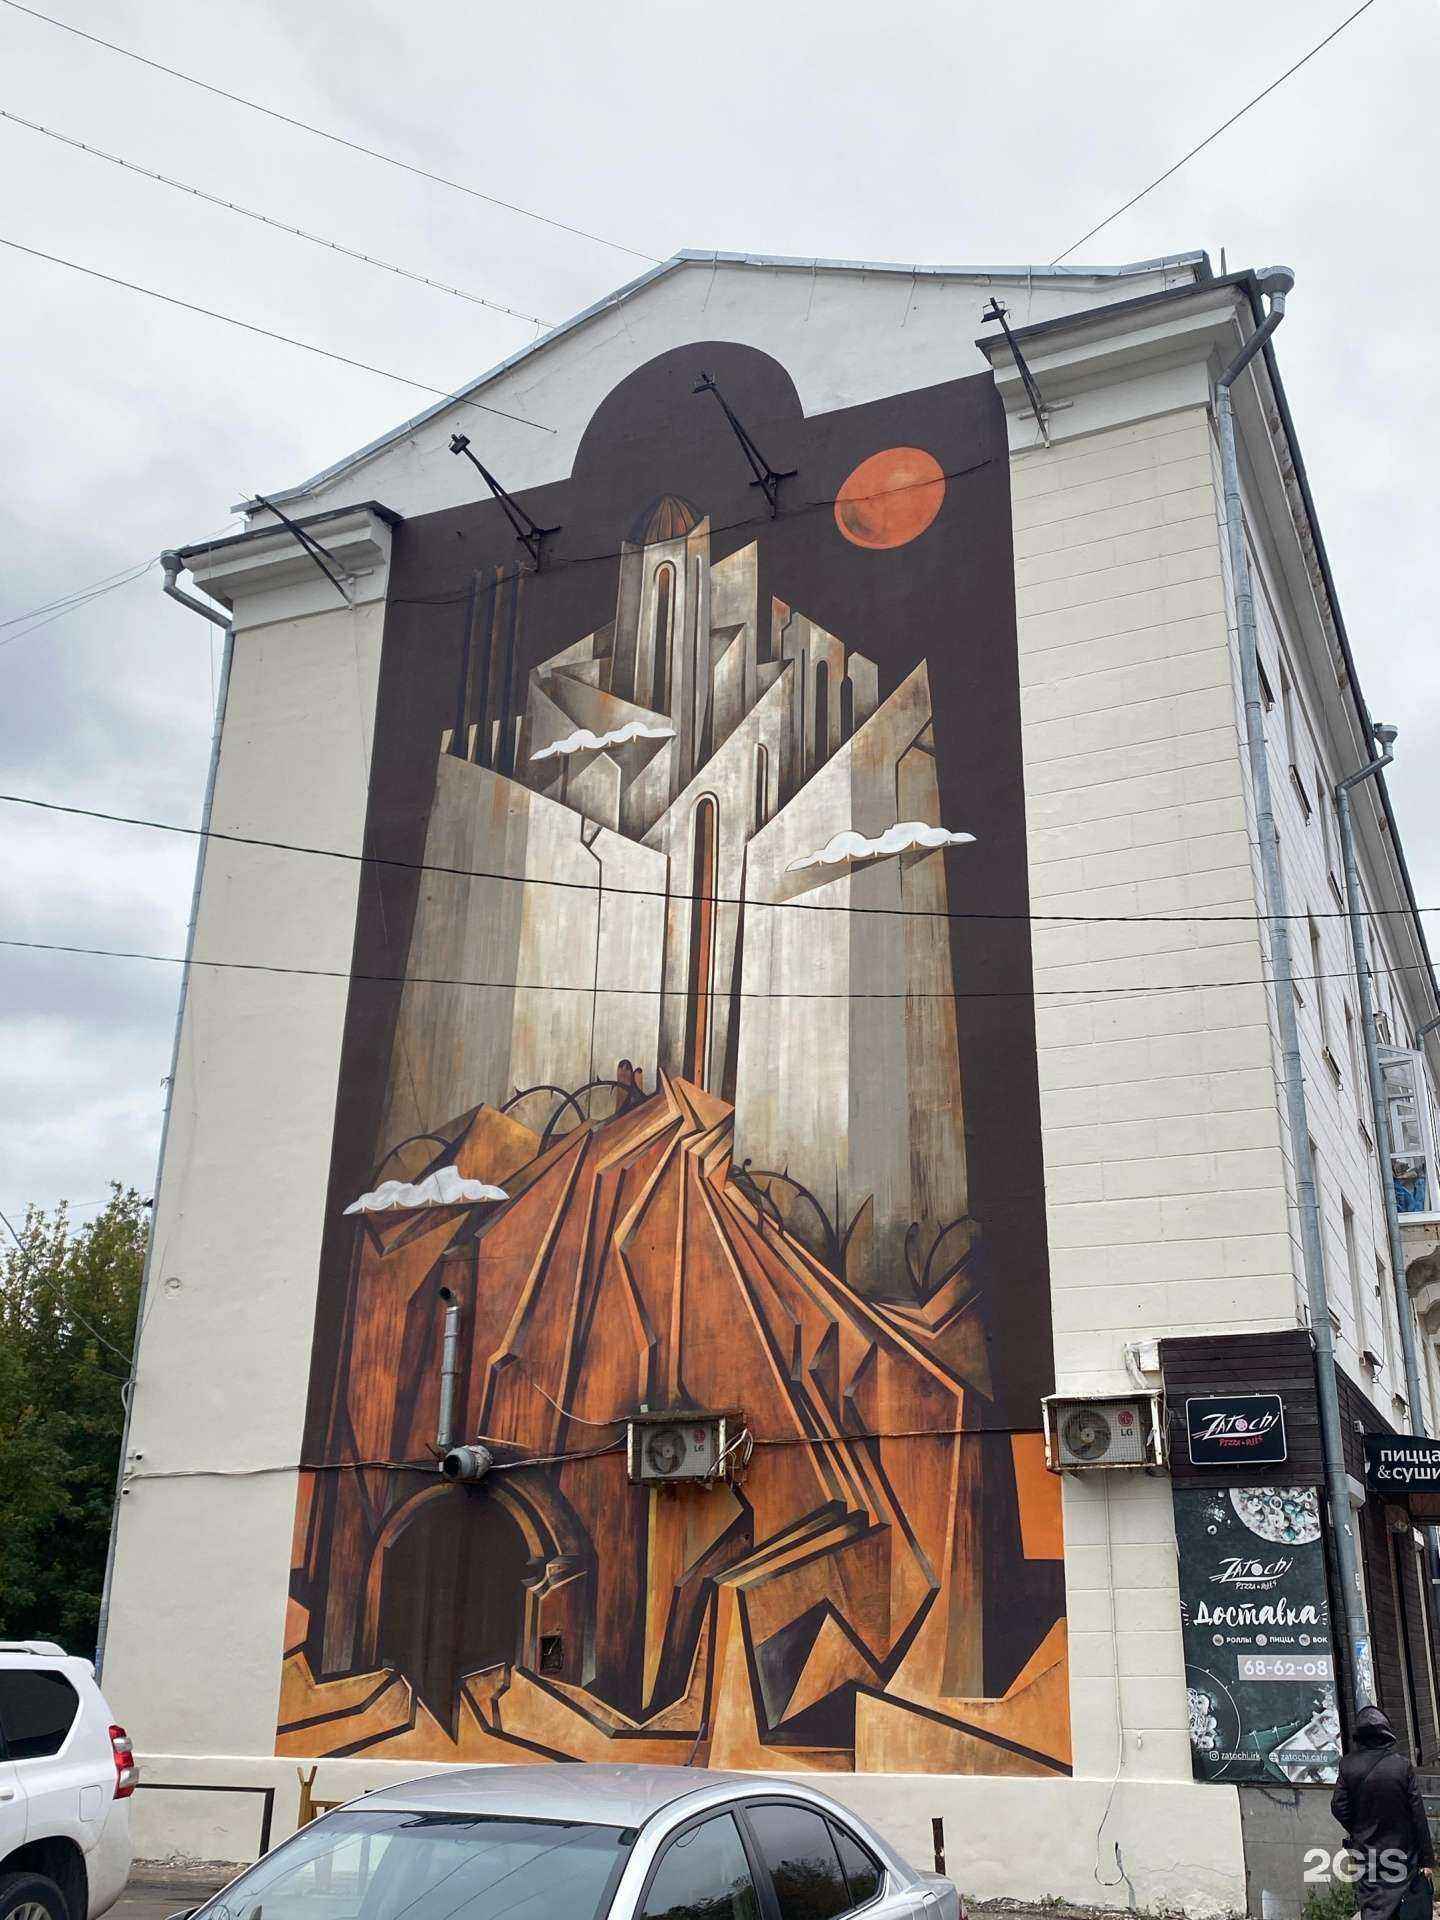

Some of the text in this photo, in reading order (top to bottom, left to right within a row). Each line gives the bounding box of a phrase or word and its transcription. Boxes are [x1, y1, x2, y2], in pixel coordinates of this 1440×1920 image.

[1120, 1428, 1133, 1436] LG
[1380, 1450, 1440, 1464] пицца
[1193, 1597, 1321, 1627] Доставка
[1226, 1636, 1328, 1644] РОЛЛЫ ПИЦЦА ВОК
[1244, 1660, 1328, 1676] 68-62-08
